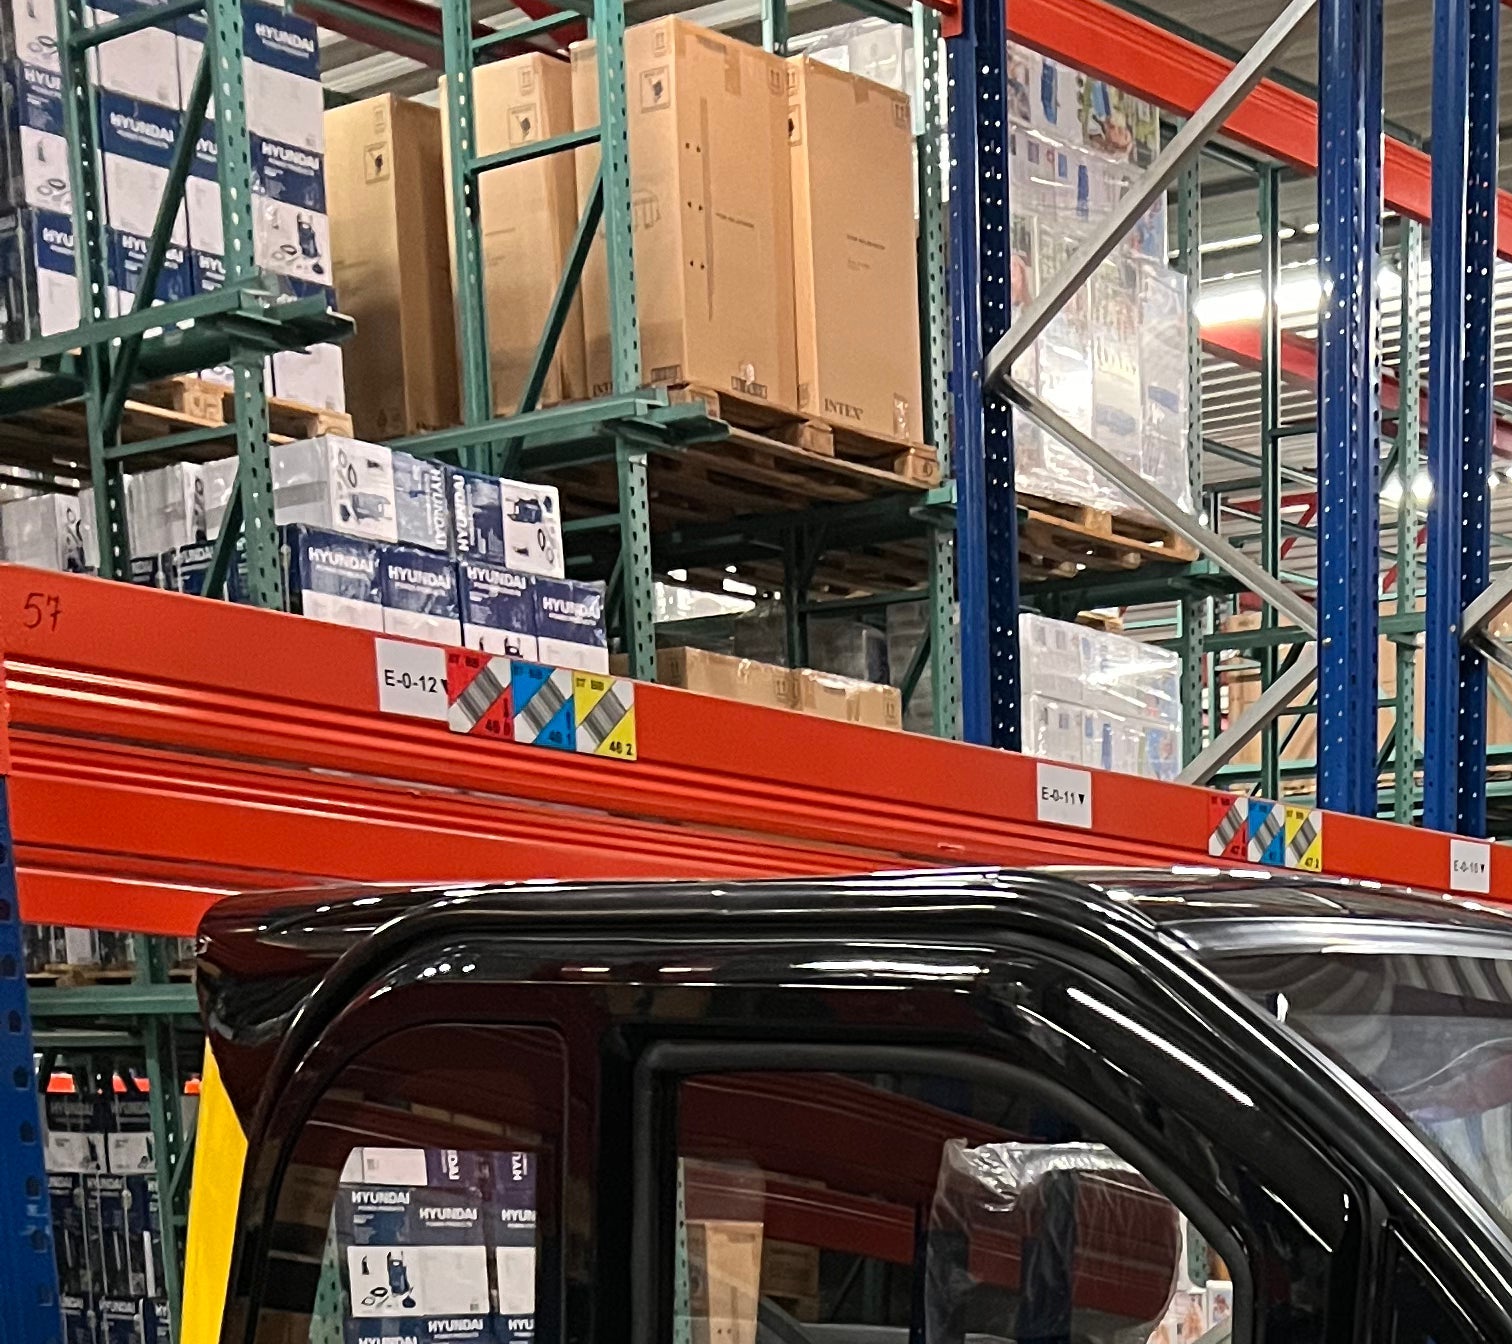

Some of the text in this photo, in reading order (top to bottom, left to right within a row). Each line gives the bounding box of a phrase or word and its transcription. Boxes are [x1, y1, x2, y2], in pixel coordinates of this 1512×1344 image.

[255, 23, 314, 52] HYUNDAI
[110, 112, 174, 142] HYUNDAI
[262, 141, 319, 170] HYUNDAI
[825, 398, 861, 420] INTEX
[431, 469, 447, 545] HYUNDAI
[453, 474, 470, 551] HYUNDAI
[308, 547, 374, 572] HYUNDAI
[388, 565, 451, 589] HYUNDAI
[467, 567, 526, 589] HYUNDAI
[23, 592, 62, 631] 57
[543, 596, 600, 620] HYUNDAI
[384, 668, 438, 693] E-0-12
[1041, 786, 1075, 805] E-0-11
[352, 1191, 410, 1204] HYUNDAI
[420, 1208, 478, 1221] HYUNDAI
[501, 1208, 536, 1222] HYUN
[428, 1319, 484, 1333] HYUNDAI
